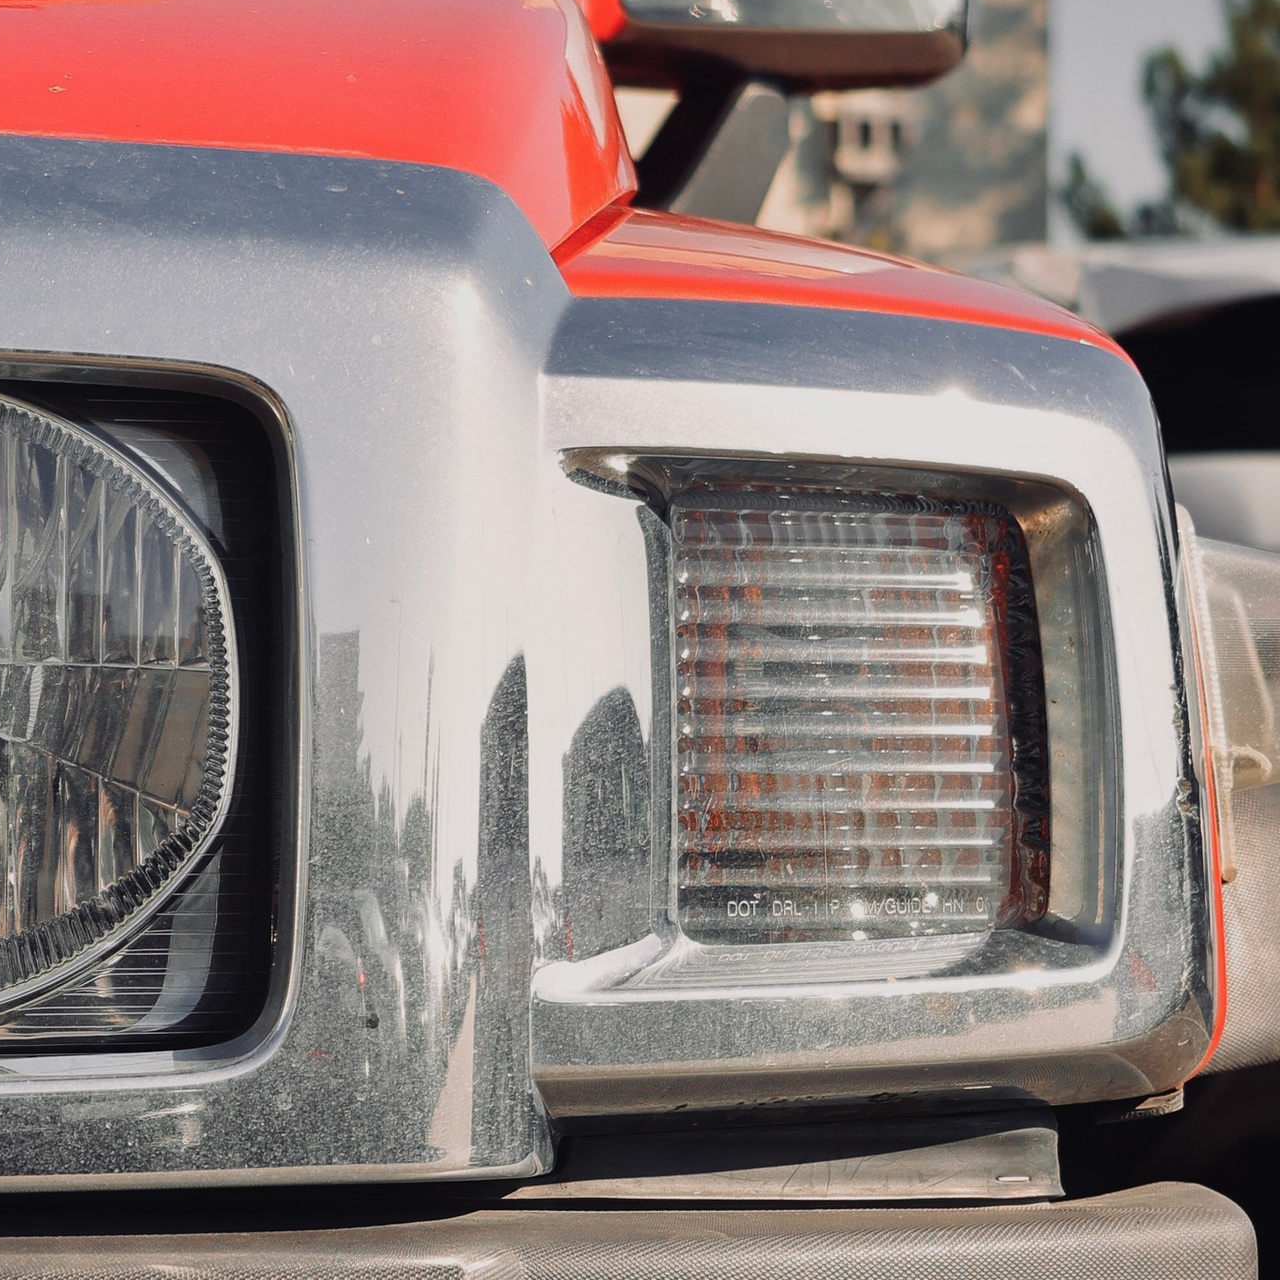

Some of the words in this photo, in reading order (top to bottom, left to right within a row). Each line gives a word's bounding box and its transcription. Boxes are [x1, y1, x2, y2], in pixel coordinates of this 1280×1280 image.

[727, 900, 759, 917] DOT
[772, 900, 802, 916] DRL
[942, 897, 964, 913] HN
